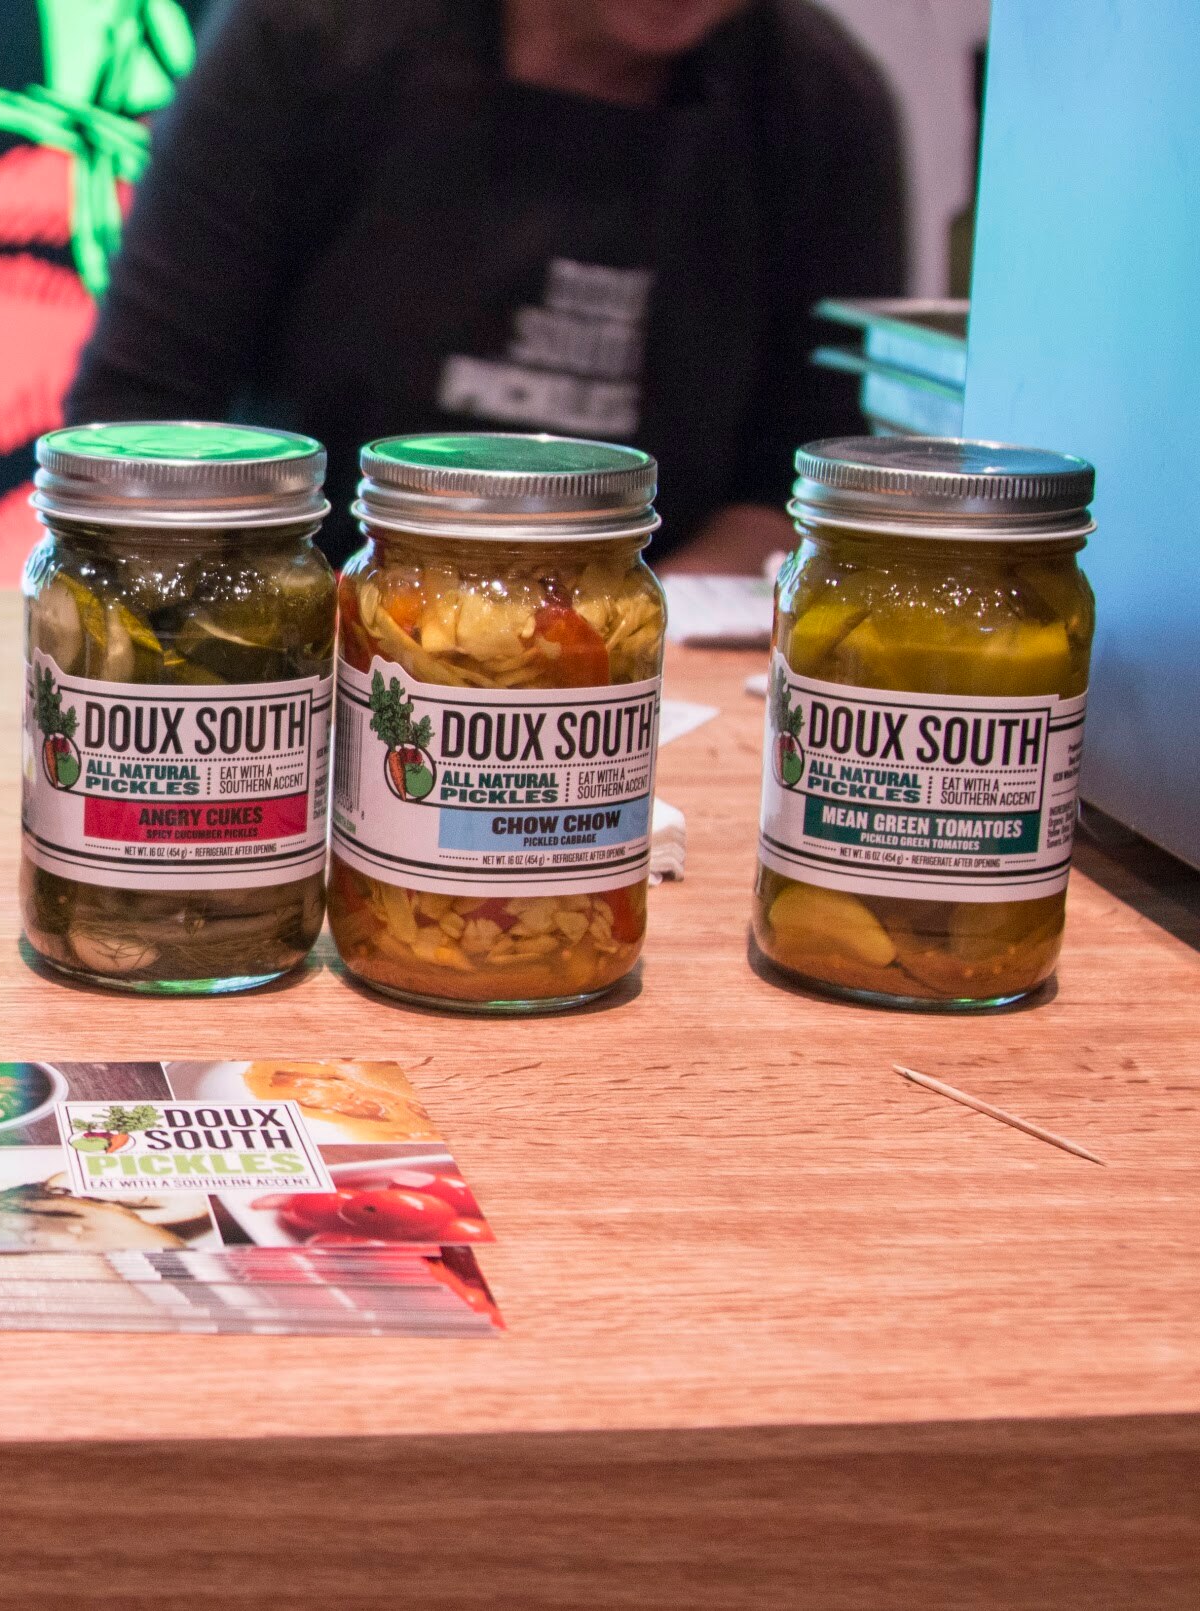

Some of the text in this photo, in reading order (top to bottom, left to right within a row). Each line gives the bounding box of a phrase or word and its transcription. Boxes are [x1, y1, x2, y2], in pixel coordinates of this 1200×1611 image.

[85, 700, 307, 755] DOUX SOUTH
[440, 701, 653, 761] DOUX SOUTH
[808, 701, 908, 760] DOUX
[917, 715, 1043, 766] SOUTH
[86, 760, 200, 780] ALL NATURAL
[220, 765, 273, 779] EAT WITH A
[441, 770, 558, 788] ALL NATURAL
[578, 768, 625, 785] EAT WITH A
[809, 760, 921, 788] ALL NATURAL
[86, 777, 200, 795] PICKLES
[220, 774, 303, 793] SOUTHERN ACCENT
[577, 775, 648, 800] SOUTHERN ACCENT
[807, 776, 921, 803] PICKLES
[942, 777, 999, 791] EAT WITH A
[440, 789, 558, 804] PICKLES
[940, 791, 1036, 806] SOUTHERN ACCENT
[139, 806, 263, 826] ANGRY CUKES
[492, 810, 621, 834] CHOW CHOW
[822, 806, 868, 829] MEAN
[874, 813, 929, 835] GREEN
[936, 818, 1022, 838] TOMATOES
[147, 828, 258, 839] SPICY CUCUMBER PICKLES
[523, 834, 597, 846] PICKLED CABBAGE
[861, 832, 979, 850] PICKLED GREEN TOMATOES
[164, 1108, 285, 1128] DOUX
[144, 1129, 293, 1149] SOUTH
[85, 1153, 305, 1176] PICKLES
[90, 1180, 114, 1188] EAT
[121, 1179, 157, 1188] WITH
[174, 1178, 251, 1188] SOUTHERN
[256, 1177, 310, 1186] ACCENT
